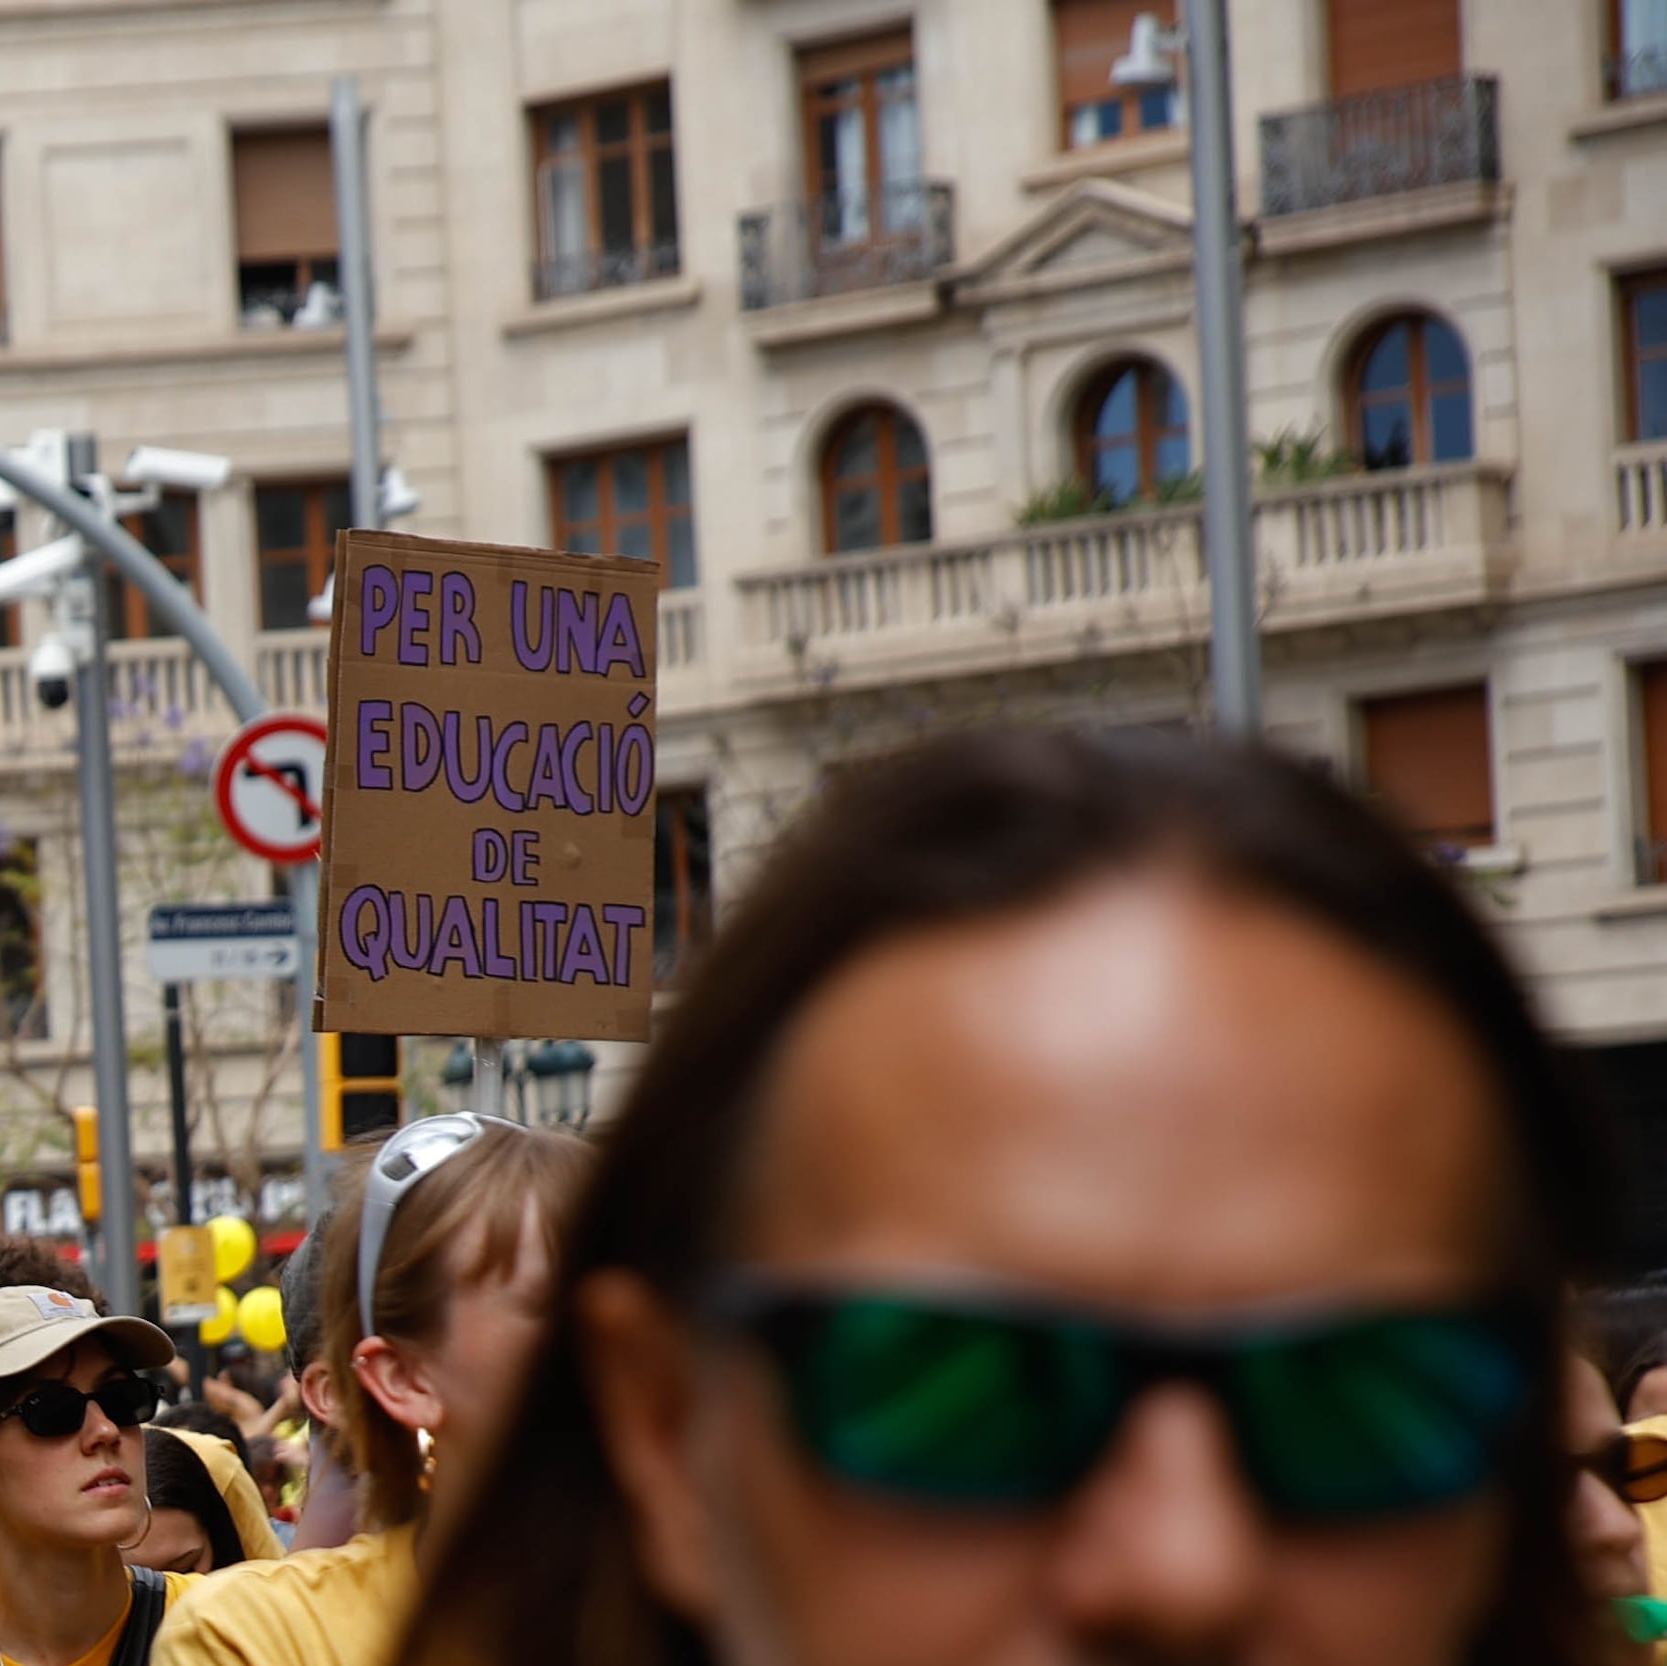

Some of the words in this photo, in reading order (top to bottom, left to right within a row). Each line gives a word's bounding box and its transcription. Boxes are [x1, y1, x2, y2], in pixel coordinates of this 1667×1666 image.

[361, 564, 482, 666] PER
[511, 580, 646, 678] UNA
[357, 691, 655, 816] EDUCACIÓ
[472, 828, 541, 886] DE
[339, 884, 645, 987] QUALITAT
